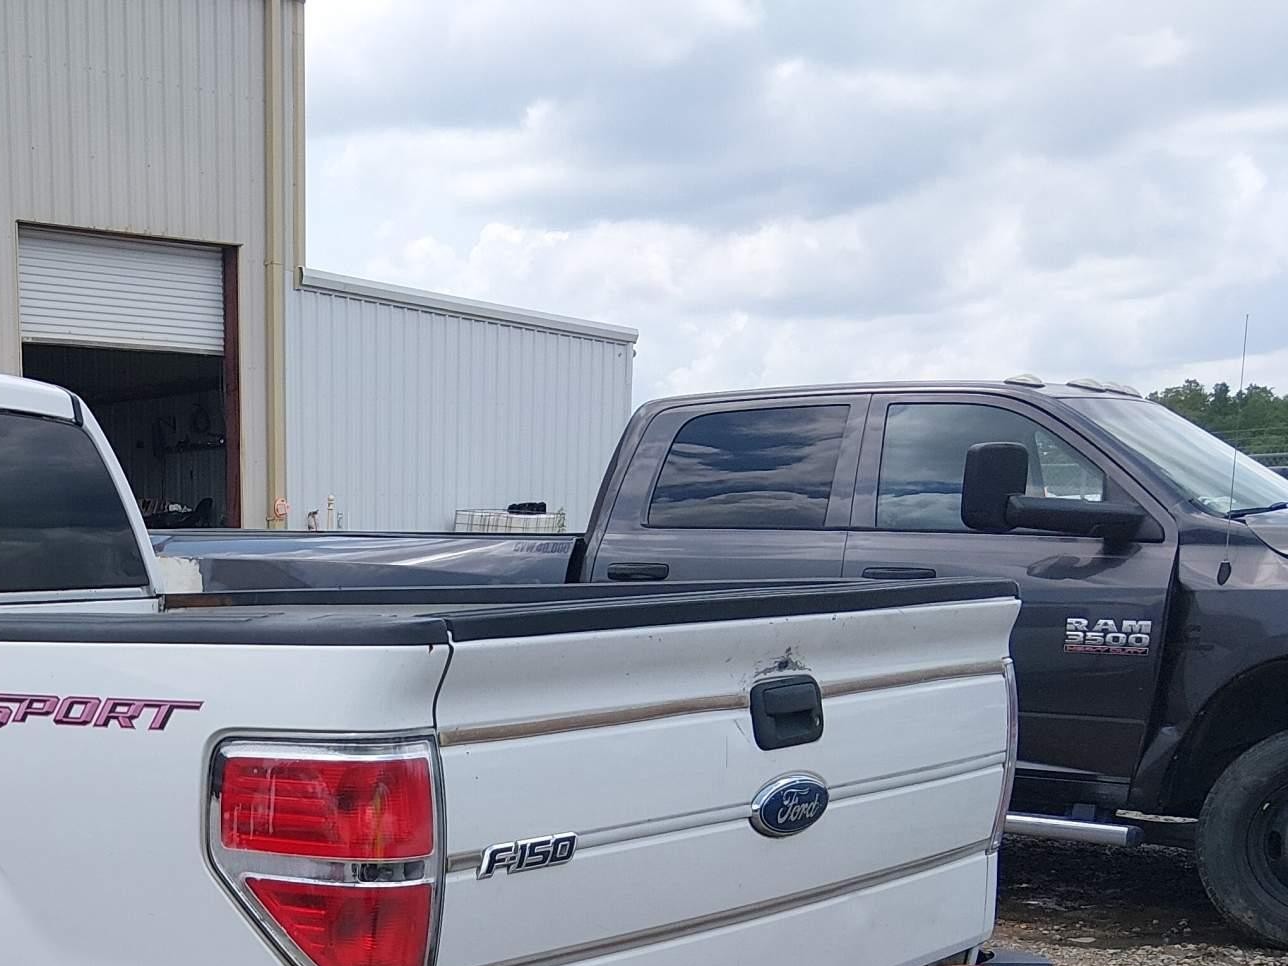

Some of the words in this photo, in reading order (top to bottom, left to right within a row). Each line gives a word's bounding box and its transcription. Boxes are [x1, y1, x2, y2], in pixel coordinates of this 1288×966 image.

[1066, 618, 1152, 633] RAM
[1065, 631, 1150, 647] 3500
[777, 787, 820, 824] Ford
[476, 832, 578, 880] F-150
